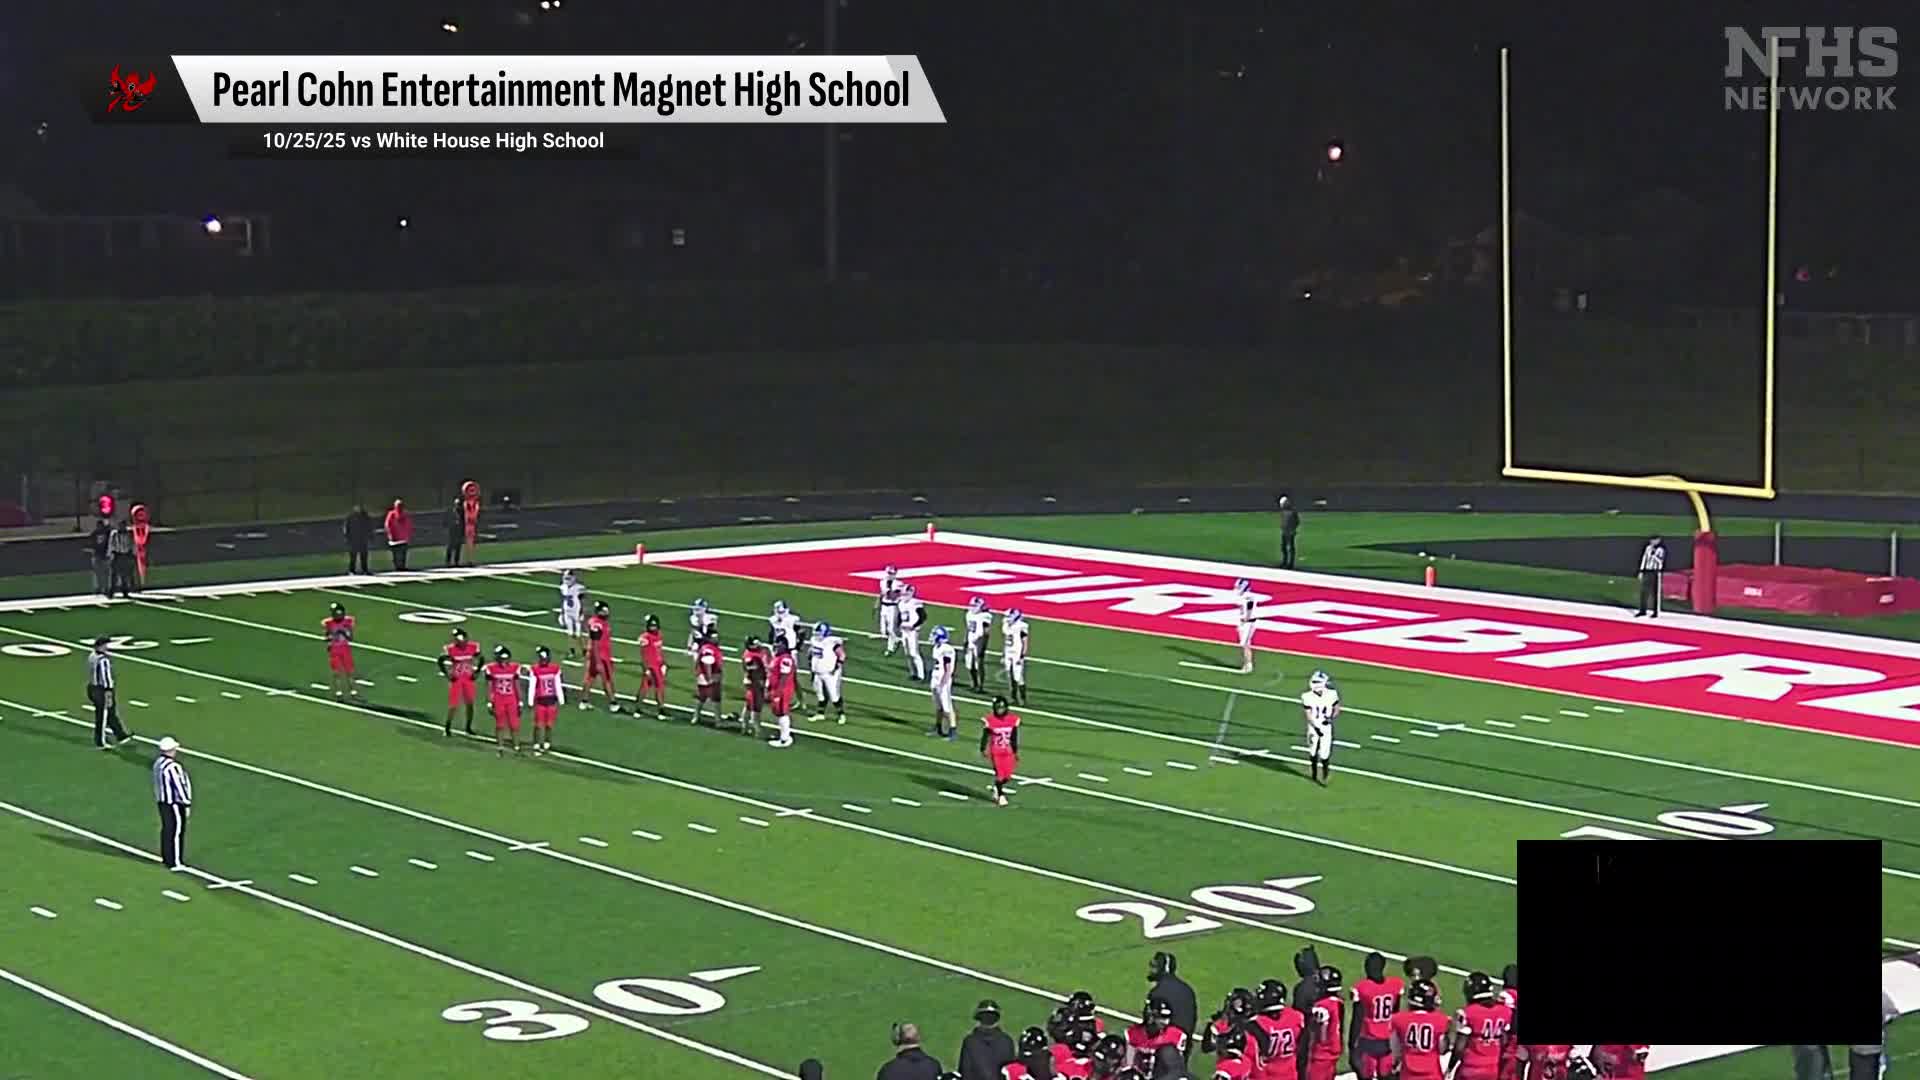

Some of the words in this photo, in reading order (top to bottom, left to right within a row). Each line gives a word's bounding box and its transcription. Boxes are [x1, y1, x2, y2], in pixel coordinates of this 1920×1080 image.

[1373, 994, 1393, 1023] 16
[1267, 1029, 1296, 1058] 72
[1405, 1022, 1434, 1052] 40
